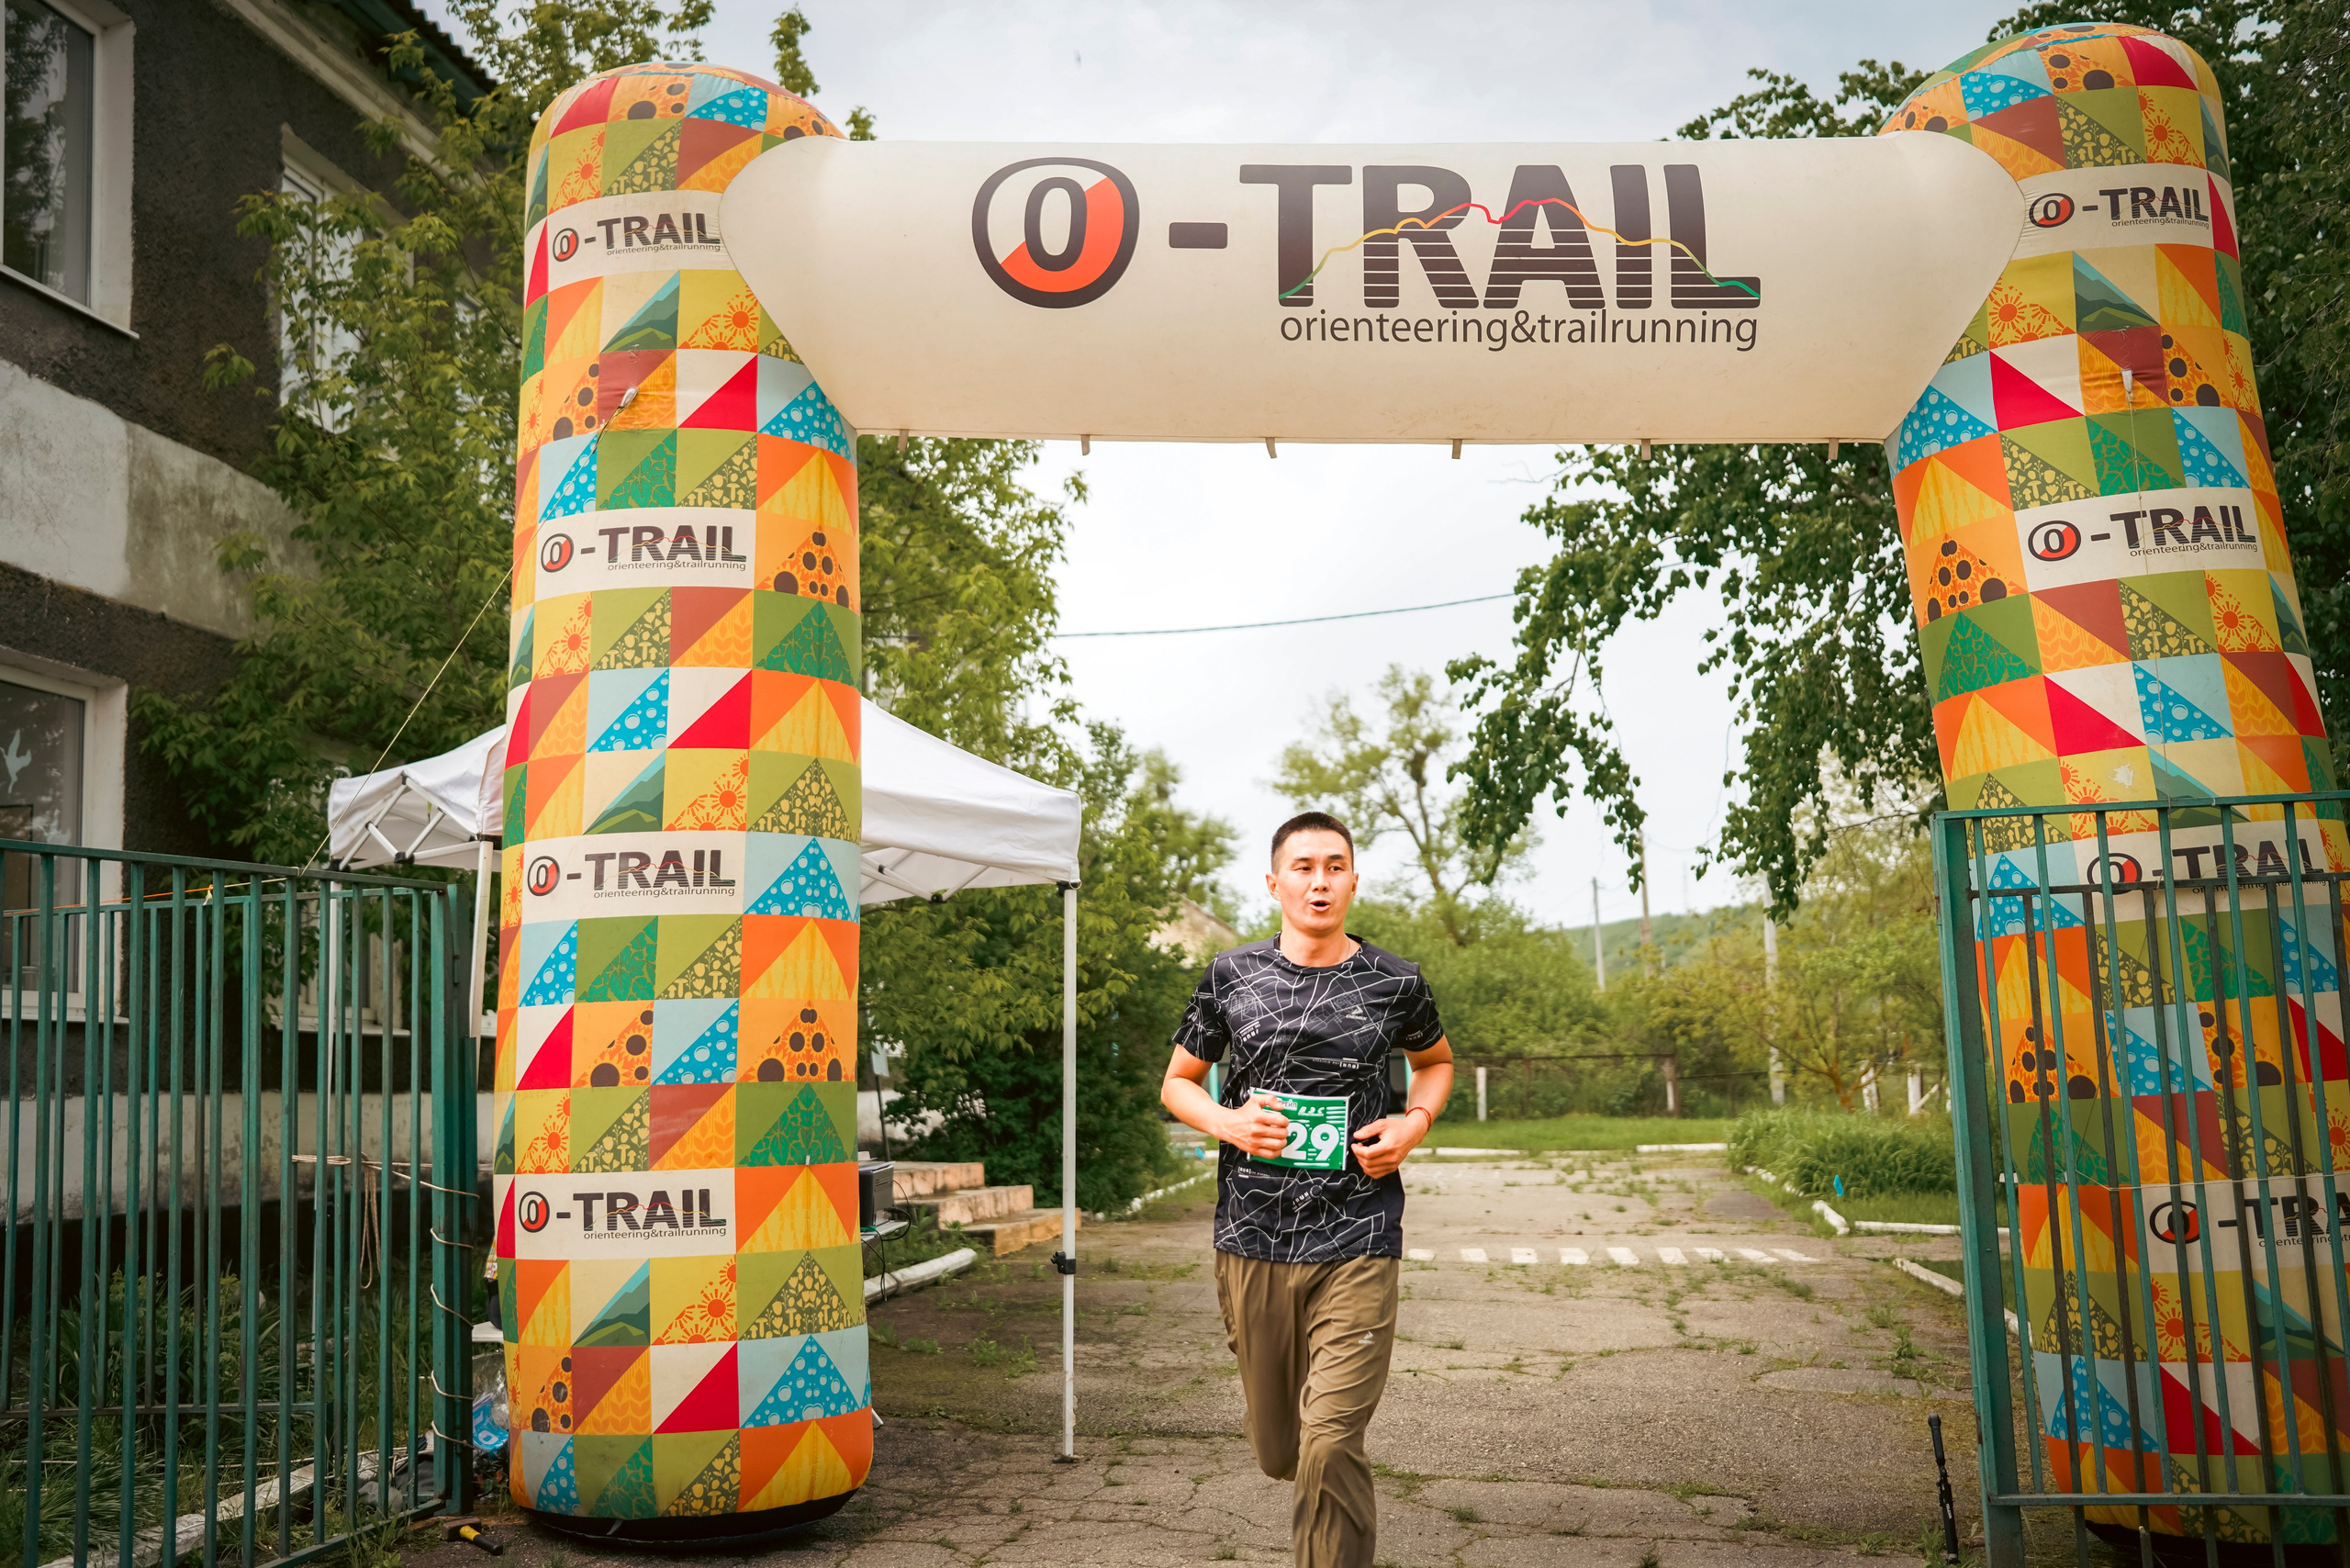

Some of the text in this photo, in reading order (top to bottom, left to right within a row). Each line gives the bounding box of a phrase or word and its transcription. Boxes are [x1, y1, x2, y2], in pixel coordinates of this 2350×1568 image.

[2111, 217, 2210, 230] orienteering&trailrunning
[607, 242, 721, 256] orienteering&trailrunning
[1280, 308, 1759, 351] orienteering&trailrunning
[607, 559, 746, 572] orienteering&trailrunning
[593, 886, 735, 899] orienteering&trailrunning
[1281, 1122, 1339, 1161] 29
[584, 1226, 727, 1239] orienteering&trailrunning
